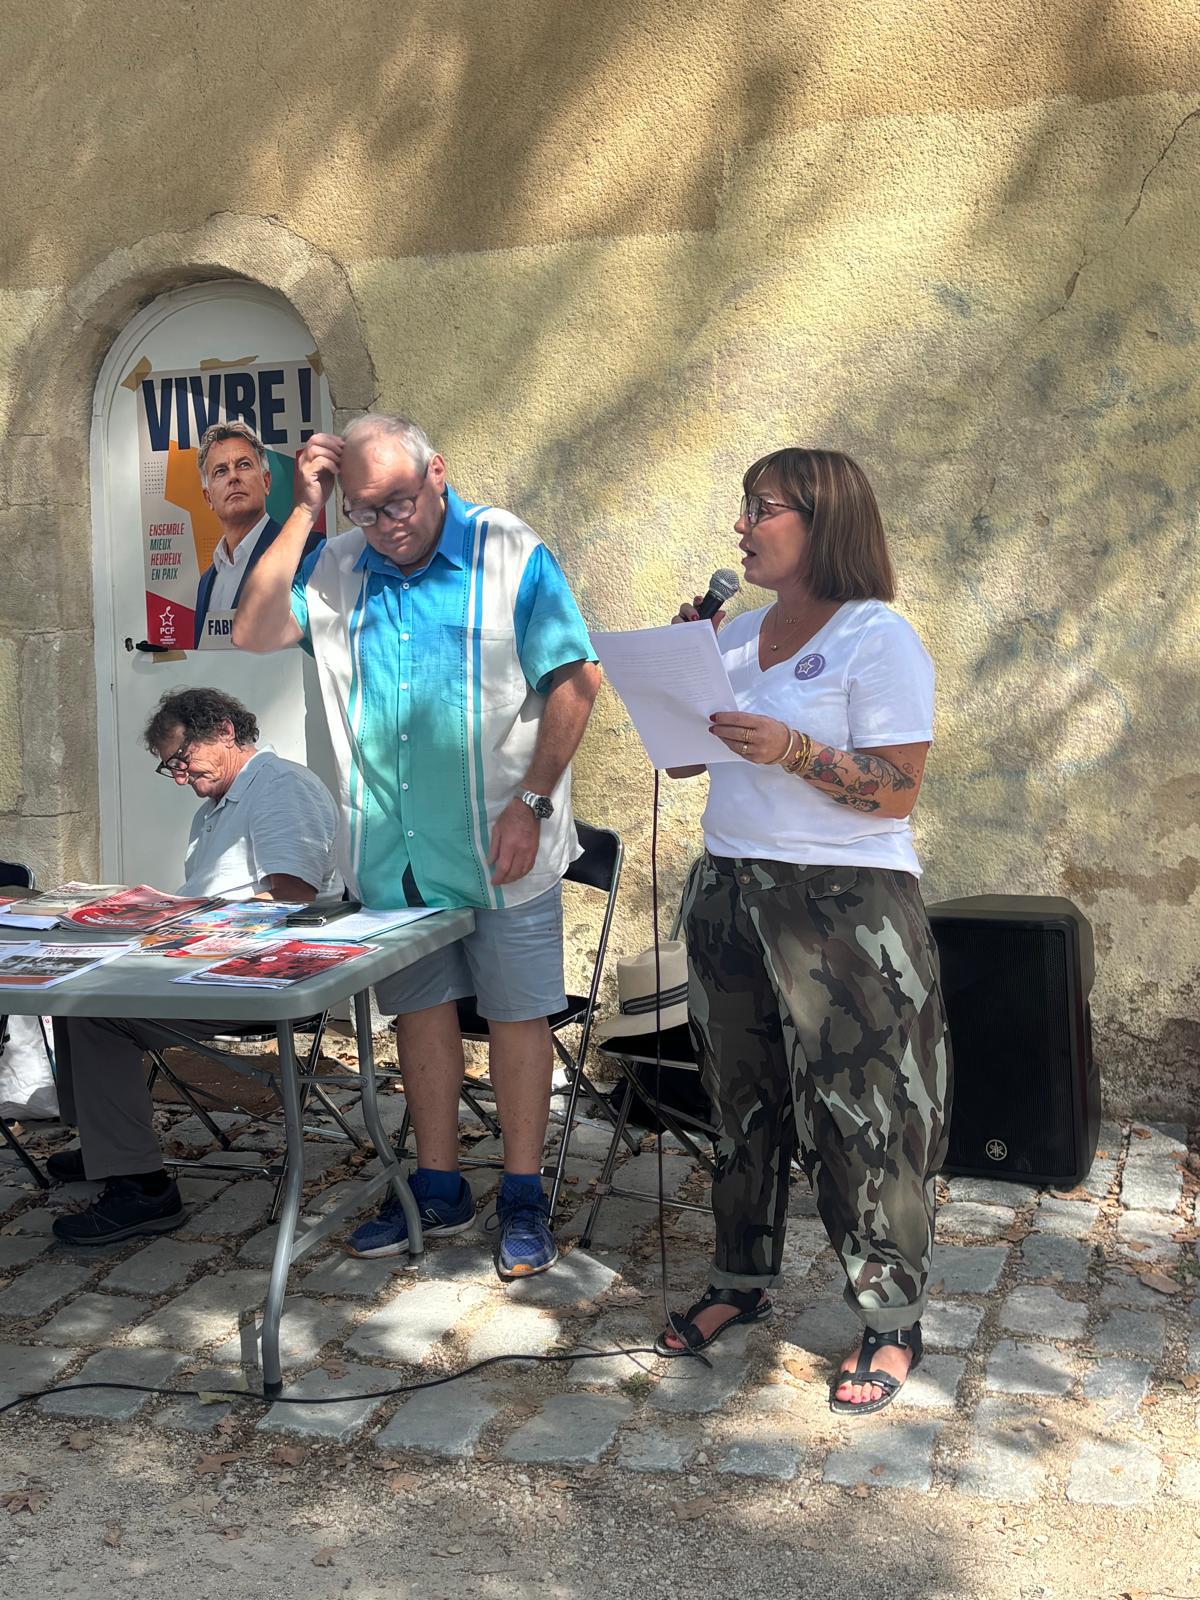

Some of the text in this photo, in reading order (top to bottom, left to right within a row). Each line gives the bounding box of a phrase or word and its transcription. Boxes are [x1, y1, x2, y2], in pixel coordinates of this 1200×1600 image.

[149, 523, 184, 536] ENSEMBLE
[150, 539, 171, 551] MIEUX
[150, 553, 182, 566] HEUREUX
[151, 567, 178, 580] EN PAIX
[160, 627, 175, 635] PCF
